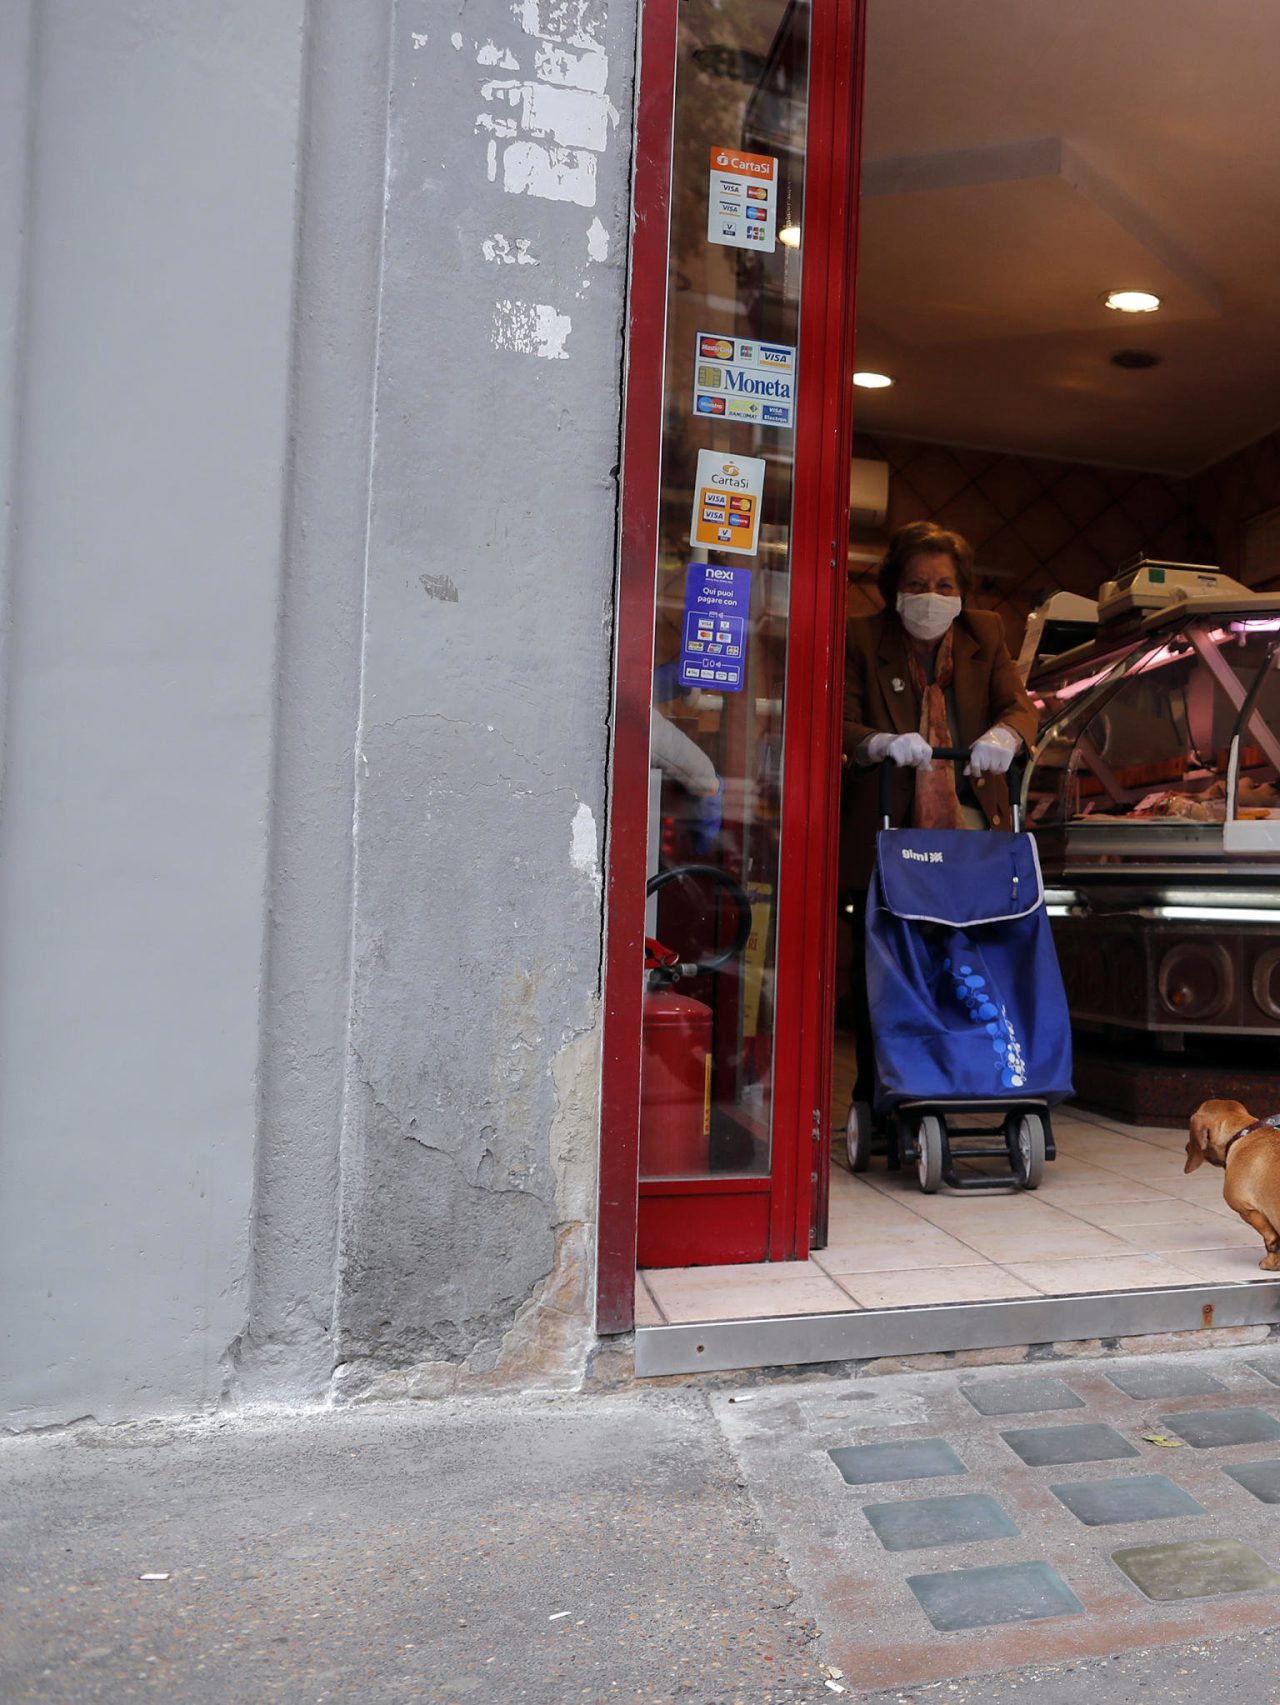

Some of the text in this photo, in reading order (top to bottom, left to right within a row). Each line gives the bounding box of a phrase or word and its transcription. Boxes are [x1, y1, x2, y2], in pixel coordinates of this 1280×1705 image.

[731, 158, 770, 174] CartaSi
[723, 184, 739, 193] VISA
[722, 204, 738, 213] VISA
[764, 352, 787, 363] VISA
[724, 369, 790, 398] Moneta
[711, 474, 749, 488] CartaSi
[707, 494, 725, 503] VISA
[705, 512, 724, 520] VISA
[705, 568, 734, 581] nexi
[703, 587, 733, 598] Qui puoi
[697, 596, 722, 605] pagare
